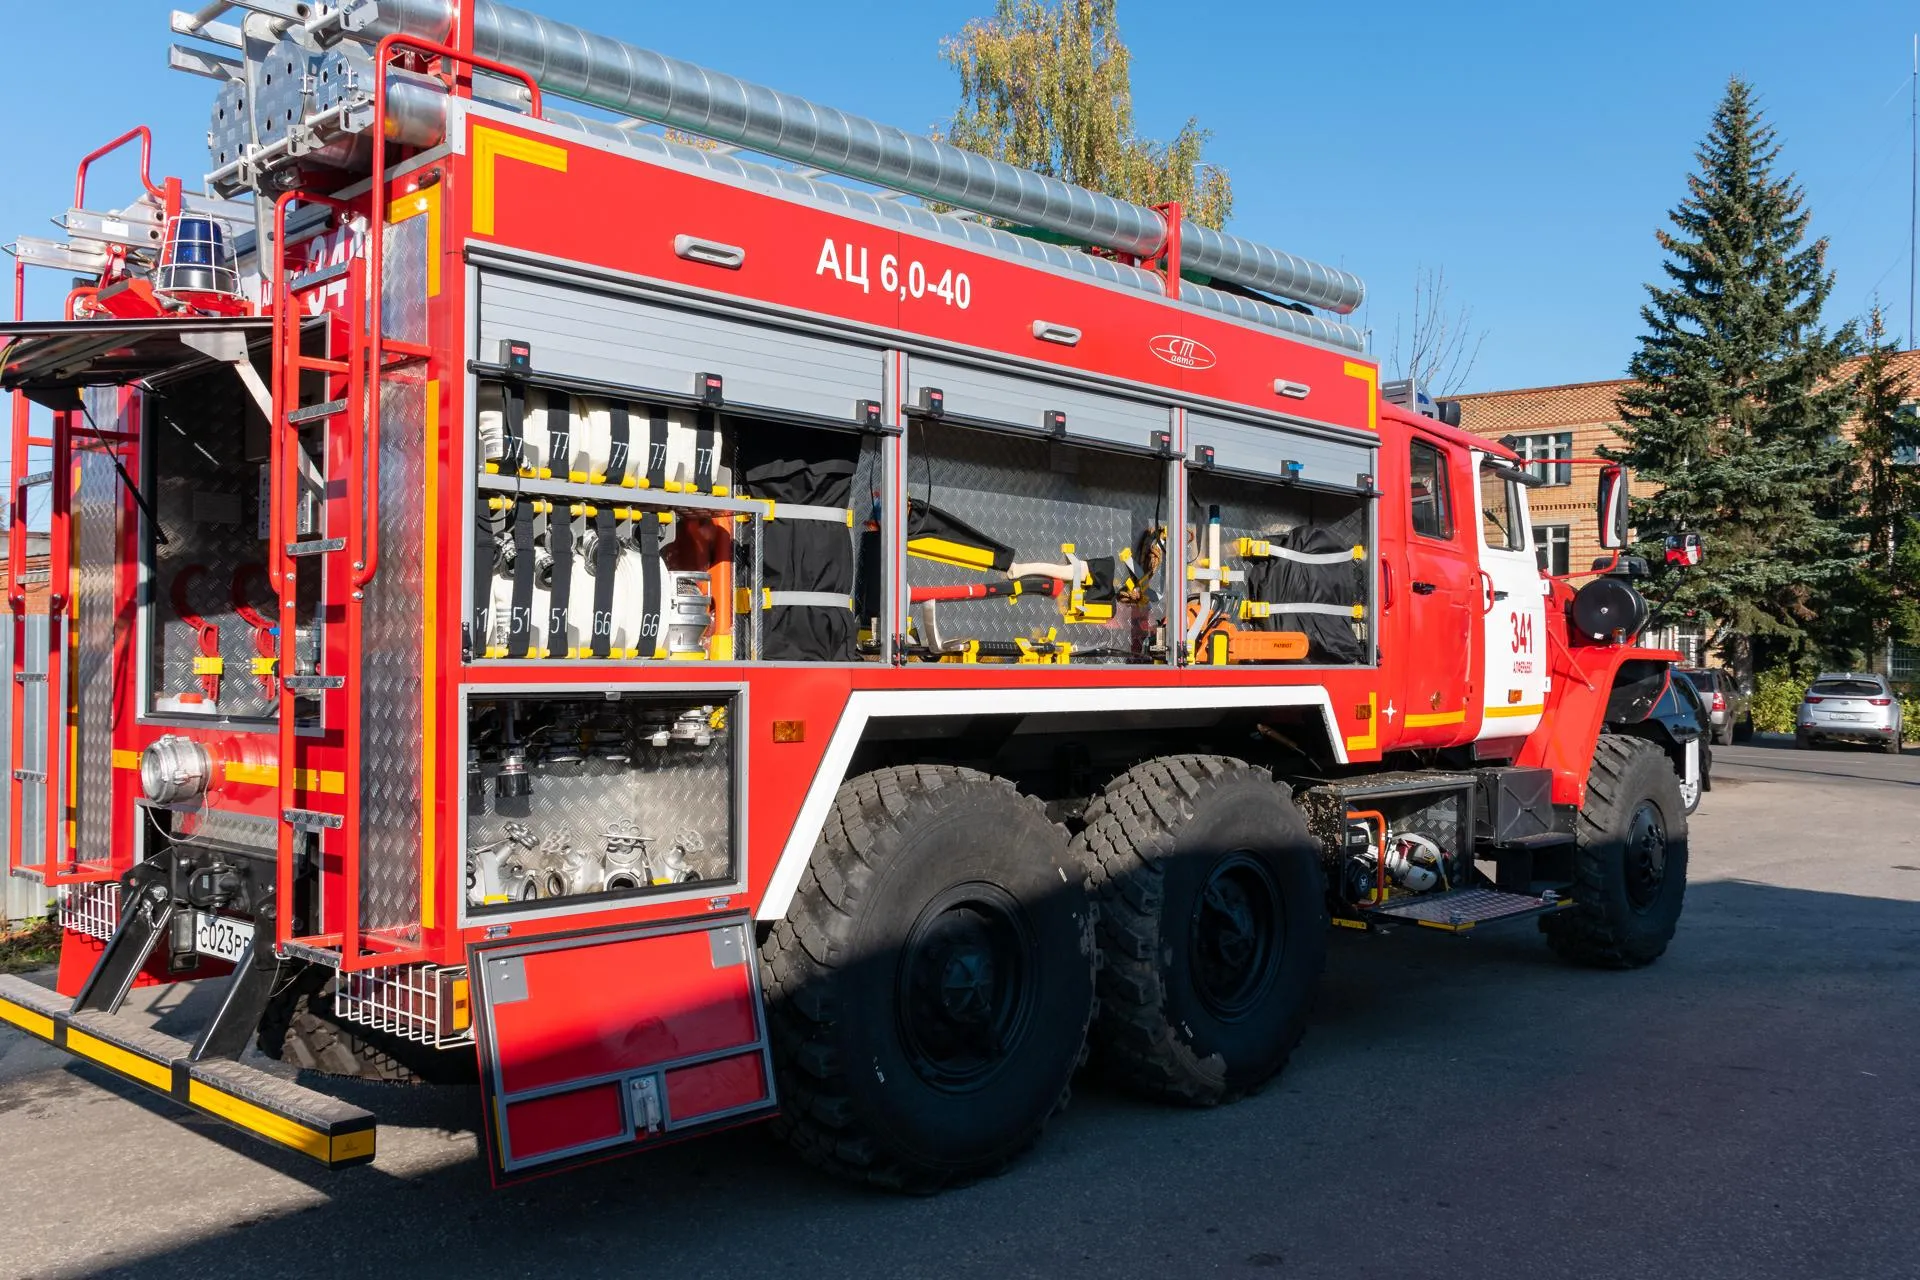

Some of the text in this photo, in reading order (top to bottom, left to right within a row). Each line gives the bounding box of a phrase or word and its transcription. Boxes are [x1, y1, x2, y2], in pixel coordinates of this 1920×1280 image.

[816, 238, 970, 309] АЦ 6,0-40
[504, 435, 523, 460] 77
[552, 431, 569, 460] 77
[611, 441, 629, 469] 77
[650, 443, 667, 470] 77
[698, 448, 713, 475] 77
[512, 607, 531, 634] 51
[551, 608, 568, 634] 51
[594, 611, 611, 635] 66
[641, 613, 660, 637] 66
[1511, 612, 1532, 653] 341
